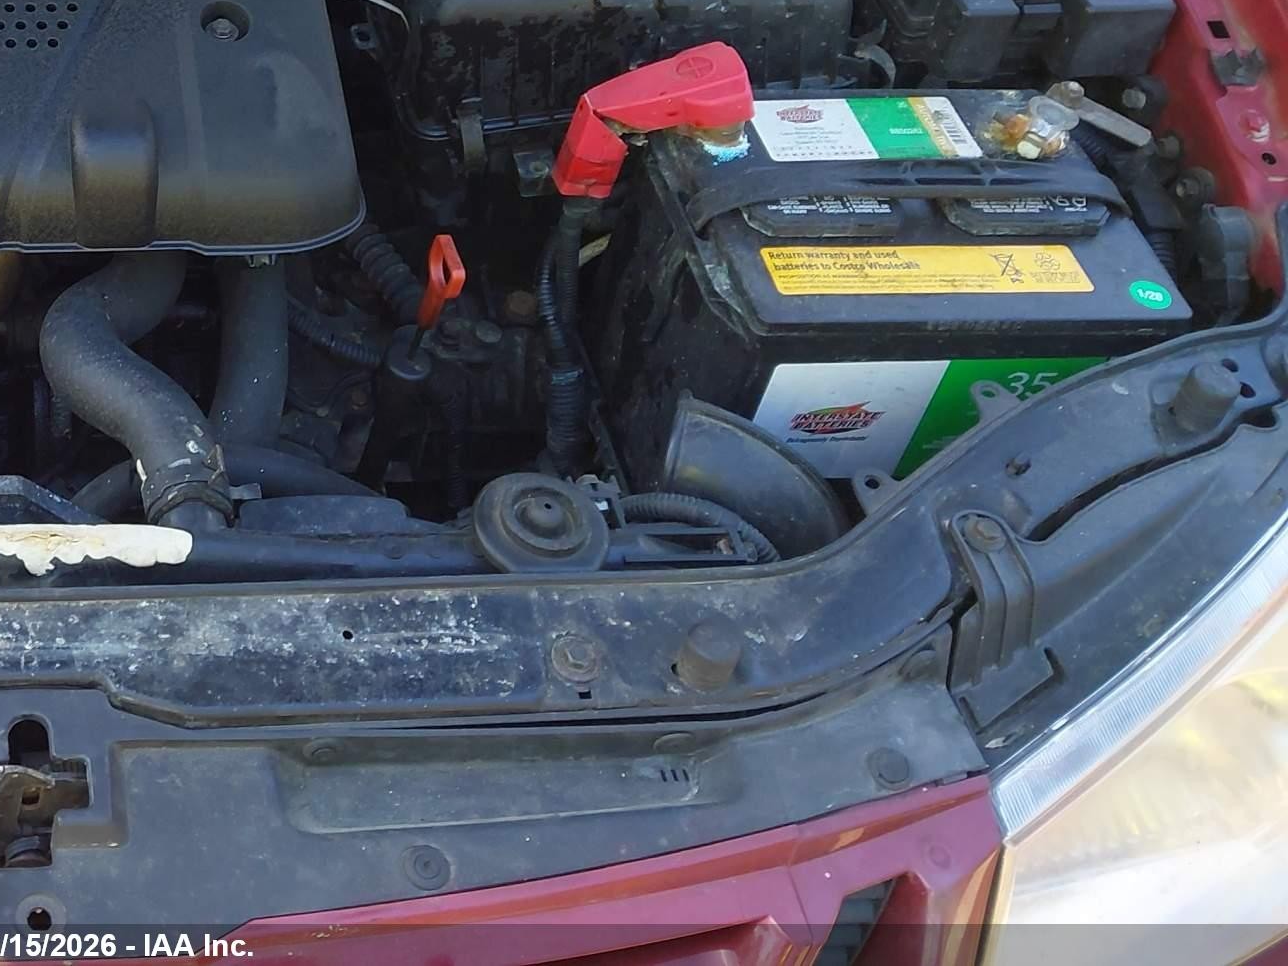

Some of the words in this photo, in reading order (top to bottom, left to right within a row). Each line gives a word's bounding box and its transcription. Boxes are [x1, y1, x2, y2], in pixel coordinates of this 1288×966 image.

[768, 251, 804, 260] Return
[805, 252, 850, 261] warranty
[853, 251, 873, 260] and
[875, 250, 899, 260] used
[774, 261, 820, 271] batteries
[822, 262, 832, 271] to
[833, 262, 866, 271] Costco
[866, 261, 920, 271] Wholesale
[1007, 371, 1059, 397] 35
[791, 411, 884, 423] INTERSTATE
[789, 421, 871, 431] BATTERIES
